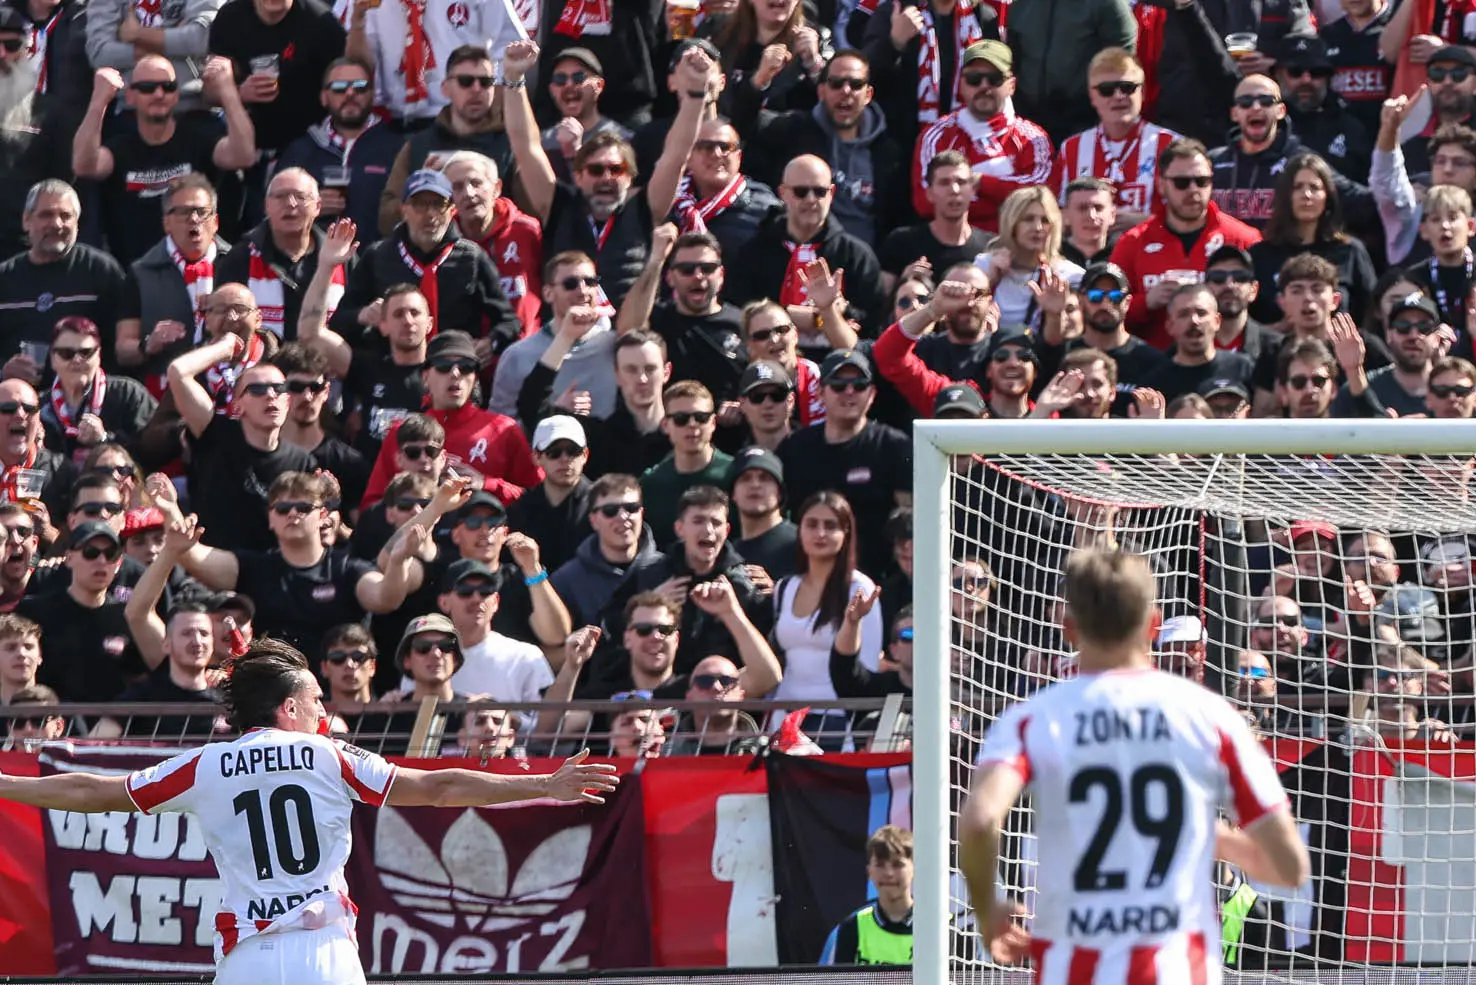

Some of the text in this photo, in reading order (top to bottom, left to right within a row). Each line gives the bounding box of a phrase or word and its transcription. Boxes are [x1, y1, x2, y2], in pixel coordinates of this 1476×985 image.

[1074, 707, 1172, 746] ZONTA
[220, 744, 314, 778] CAPELLO
[233, 784, 320, 880] 10
[1069, 762, 1184, 892] 29
[1068, 906, 1180, 937] NARDI
